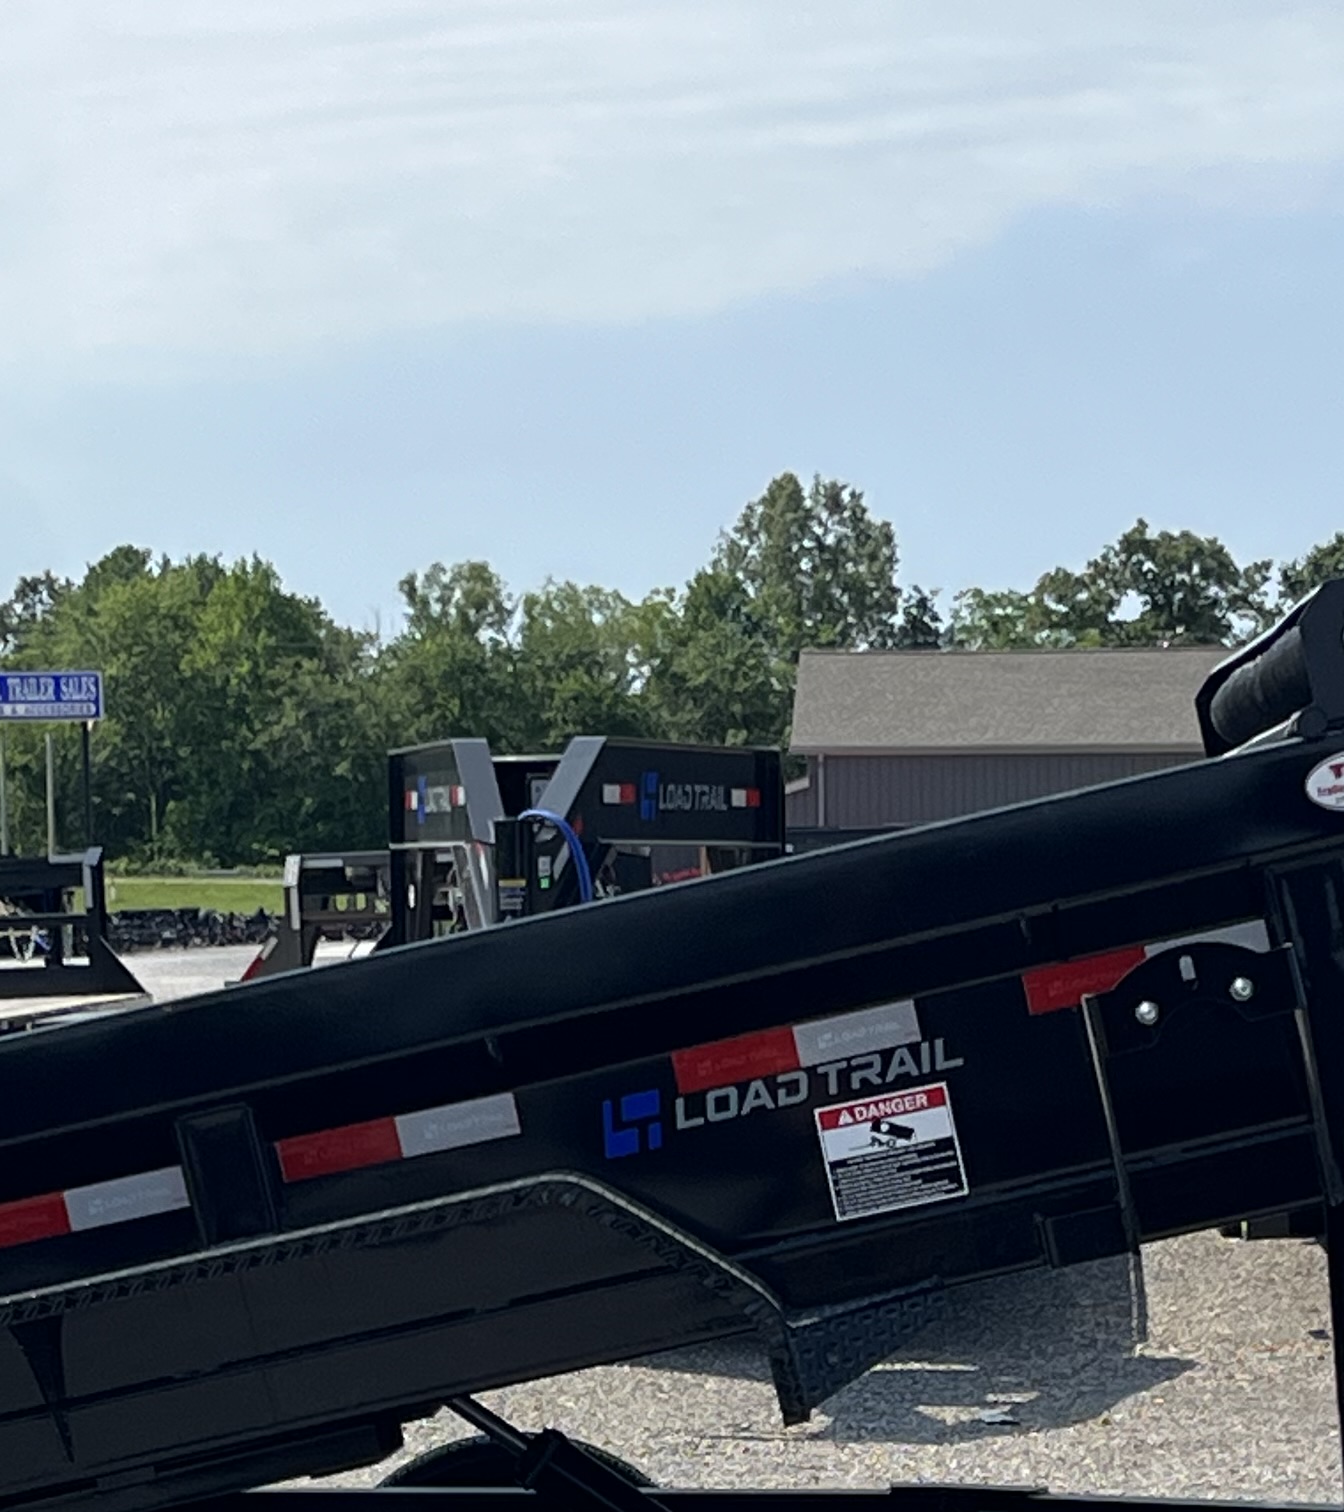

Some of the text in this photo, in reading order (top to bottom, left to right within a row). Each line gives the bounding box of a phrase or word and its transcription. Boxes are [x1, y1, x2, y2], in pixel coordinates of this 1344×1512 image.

[6, 677, 56, 701] TRAILER
[59, 676, 96, 701] SALES
[658, 783, 729, 812] LOAD TRAIL
[674, 1070, 811, 1131] LOAD
[816, 1037, 965, 1097] TRAIL
[853, 1093, 929, 1122] DANGER
